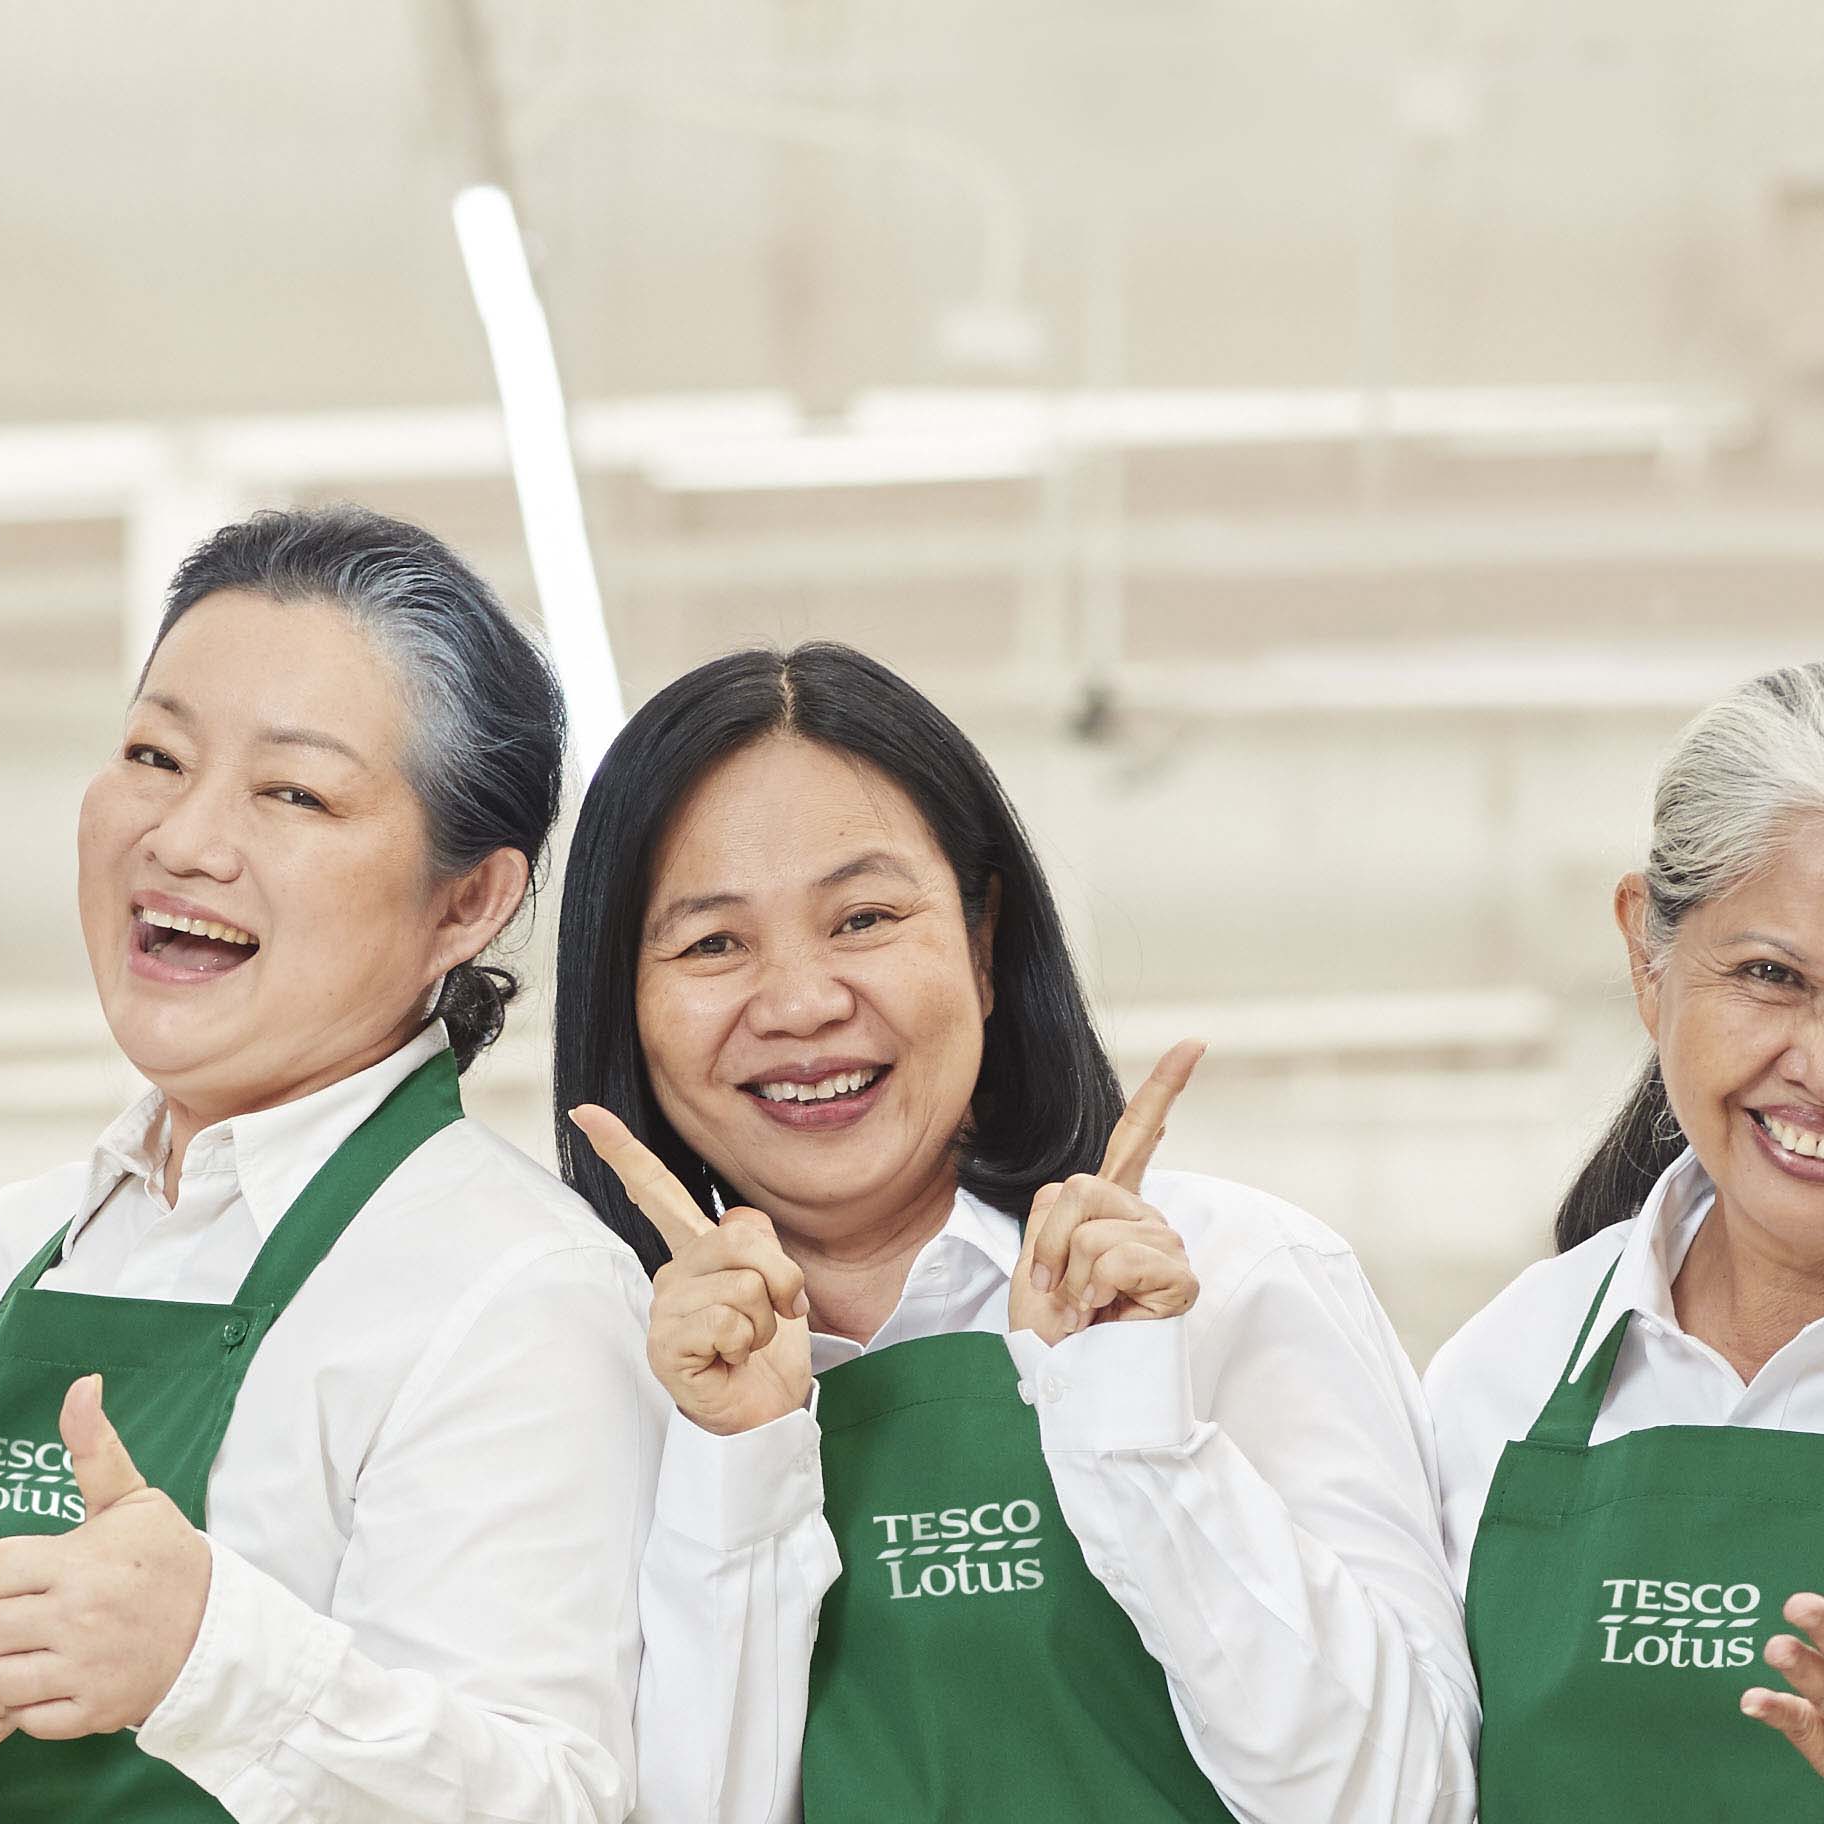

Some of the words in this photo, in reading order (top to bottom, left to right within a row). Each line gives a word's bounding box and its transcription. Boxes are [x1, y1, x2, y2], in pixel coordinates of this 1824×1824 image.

[872, 1499, 1041, 1543] TESCO
[886, 1554, 1045, 1600] Lotus
[1602, 1579, 1761, 1614] TESCO
[1600, 1626, 1755, 1669] Lotus
